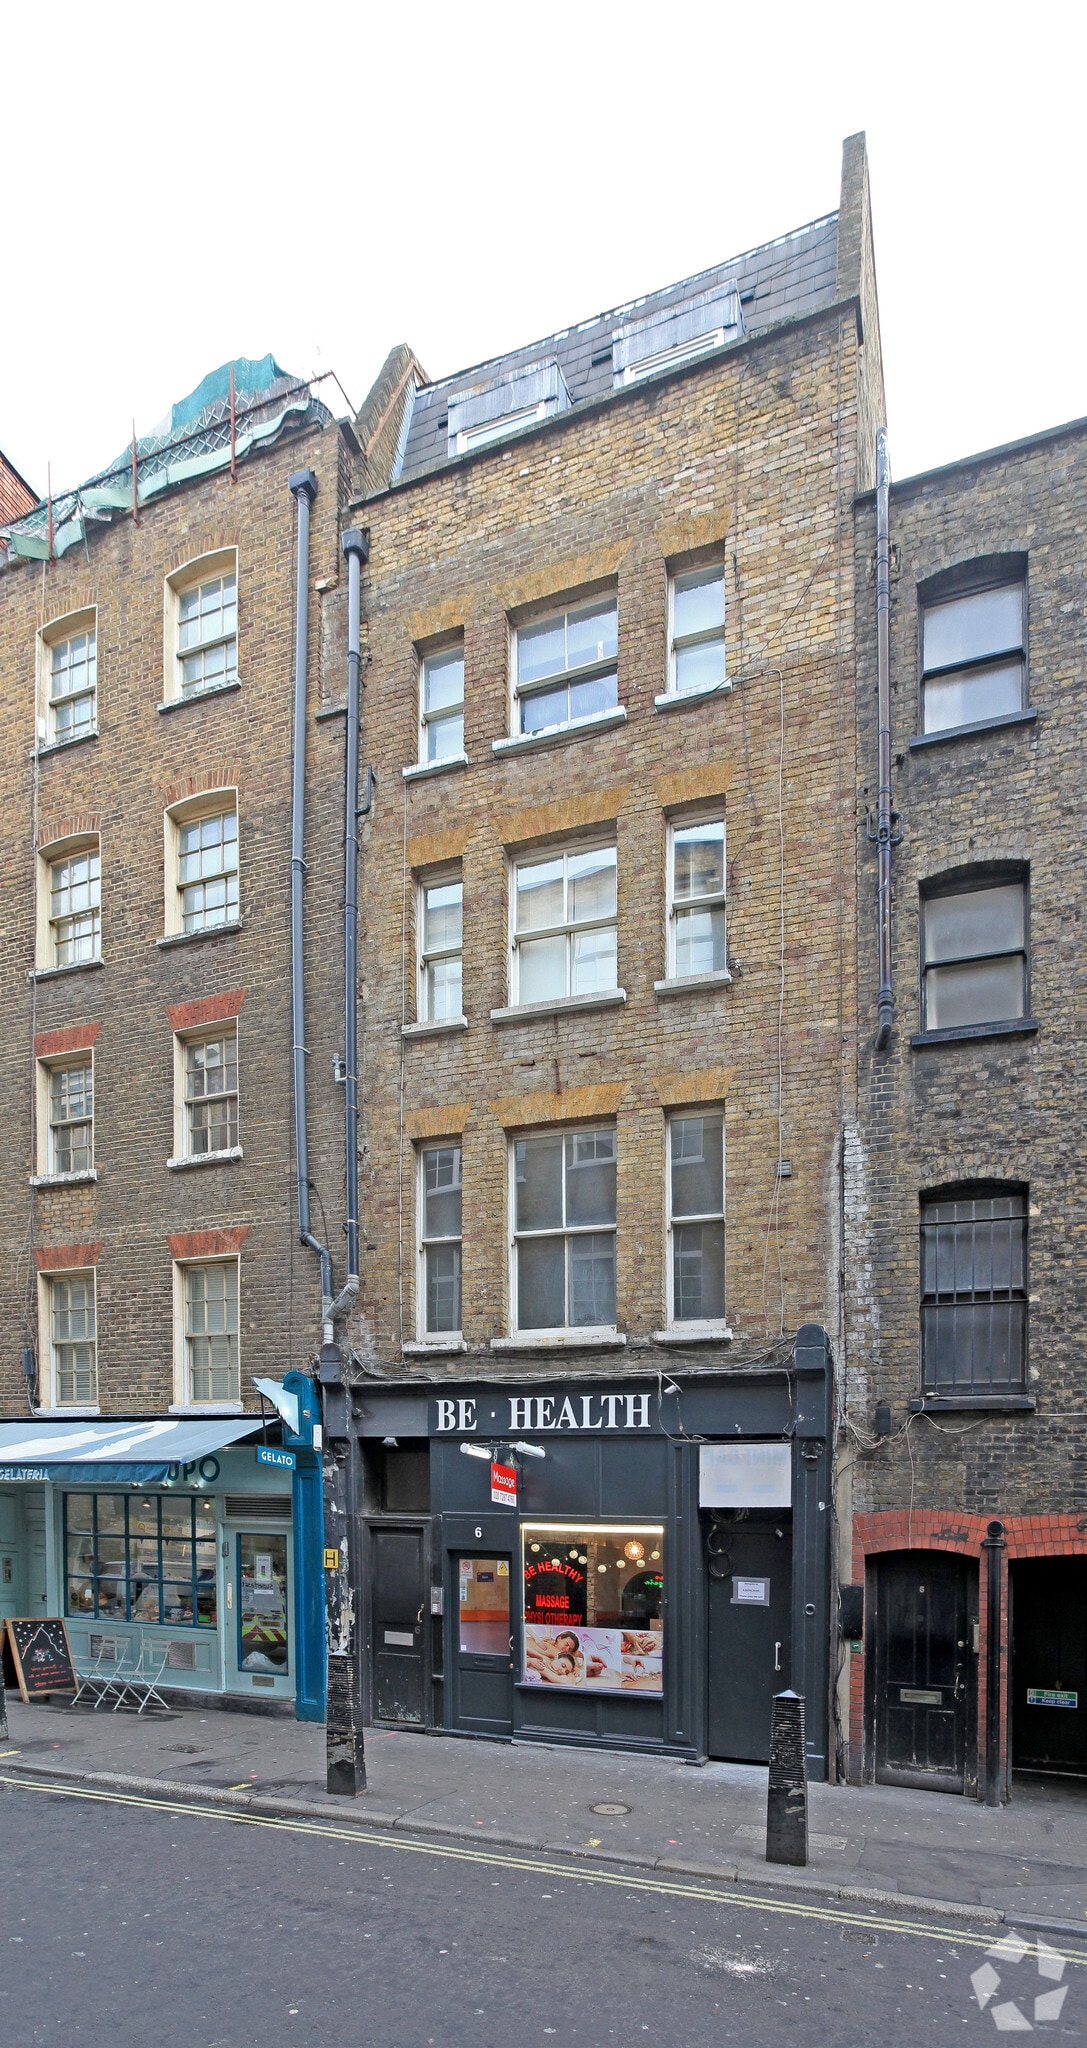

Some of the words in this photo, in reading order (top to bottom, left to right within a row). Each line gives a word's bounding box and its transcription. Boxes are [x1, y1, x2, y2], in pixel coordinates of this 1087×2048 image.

[435, 1398, 478, 1431] BE
[508, 1393, 652, 1430] HEALTH
[261, 1451, 293, 1466] GELATO
[0, 1468, 50, 1481] GELATERIA
[493, 1470, 515, 1489] Massage
[474, 1527, 482, 1538] 6
[325, 1551, 336, 1567] H
[524, 1565, 537, 1580] BE
[535, 1594, 570, 1609] MASSAGE
[415, 1625, 421, 1635] 6
